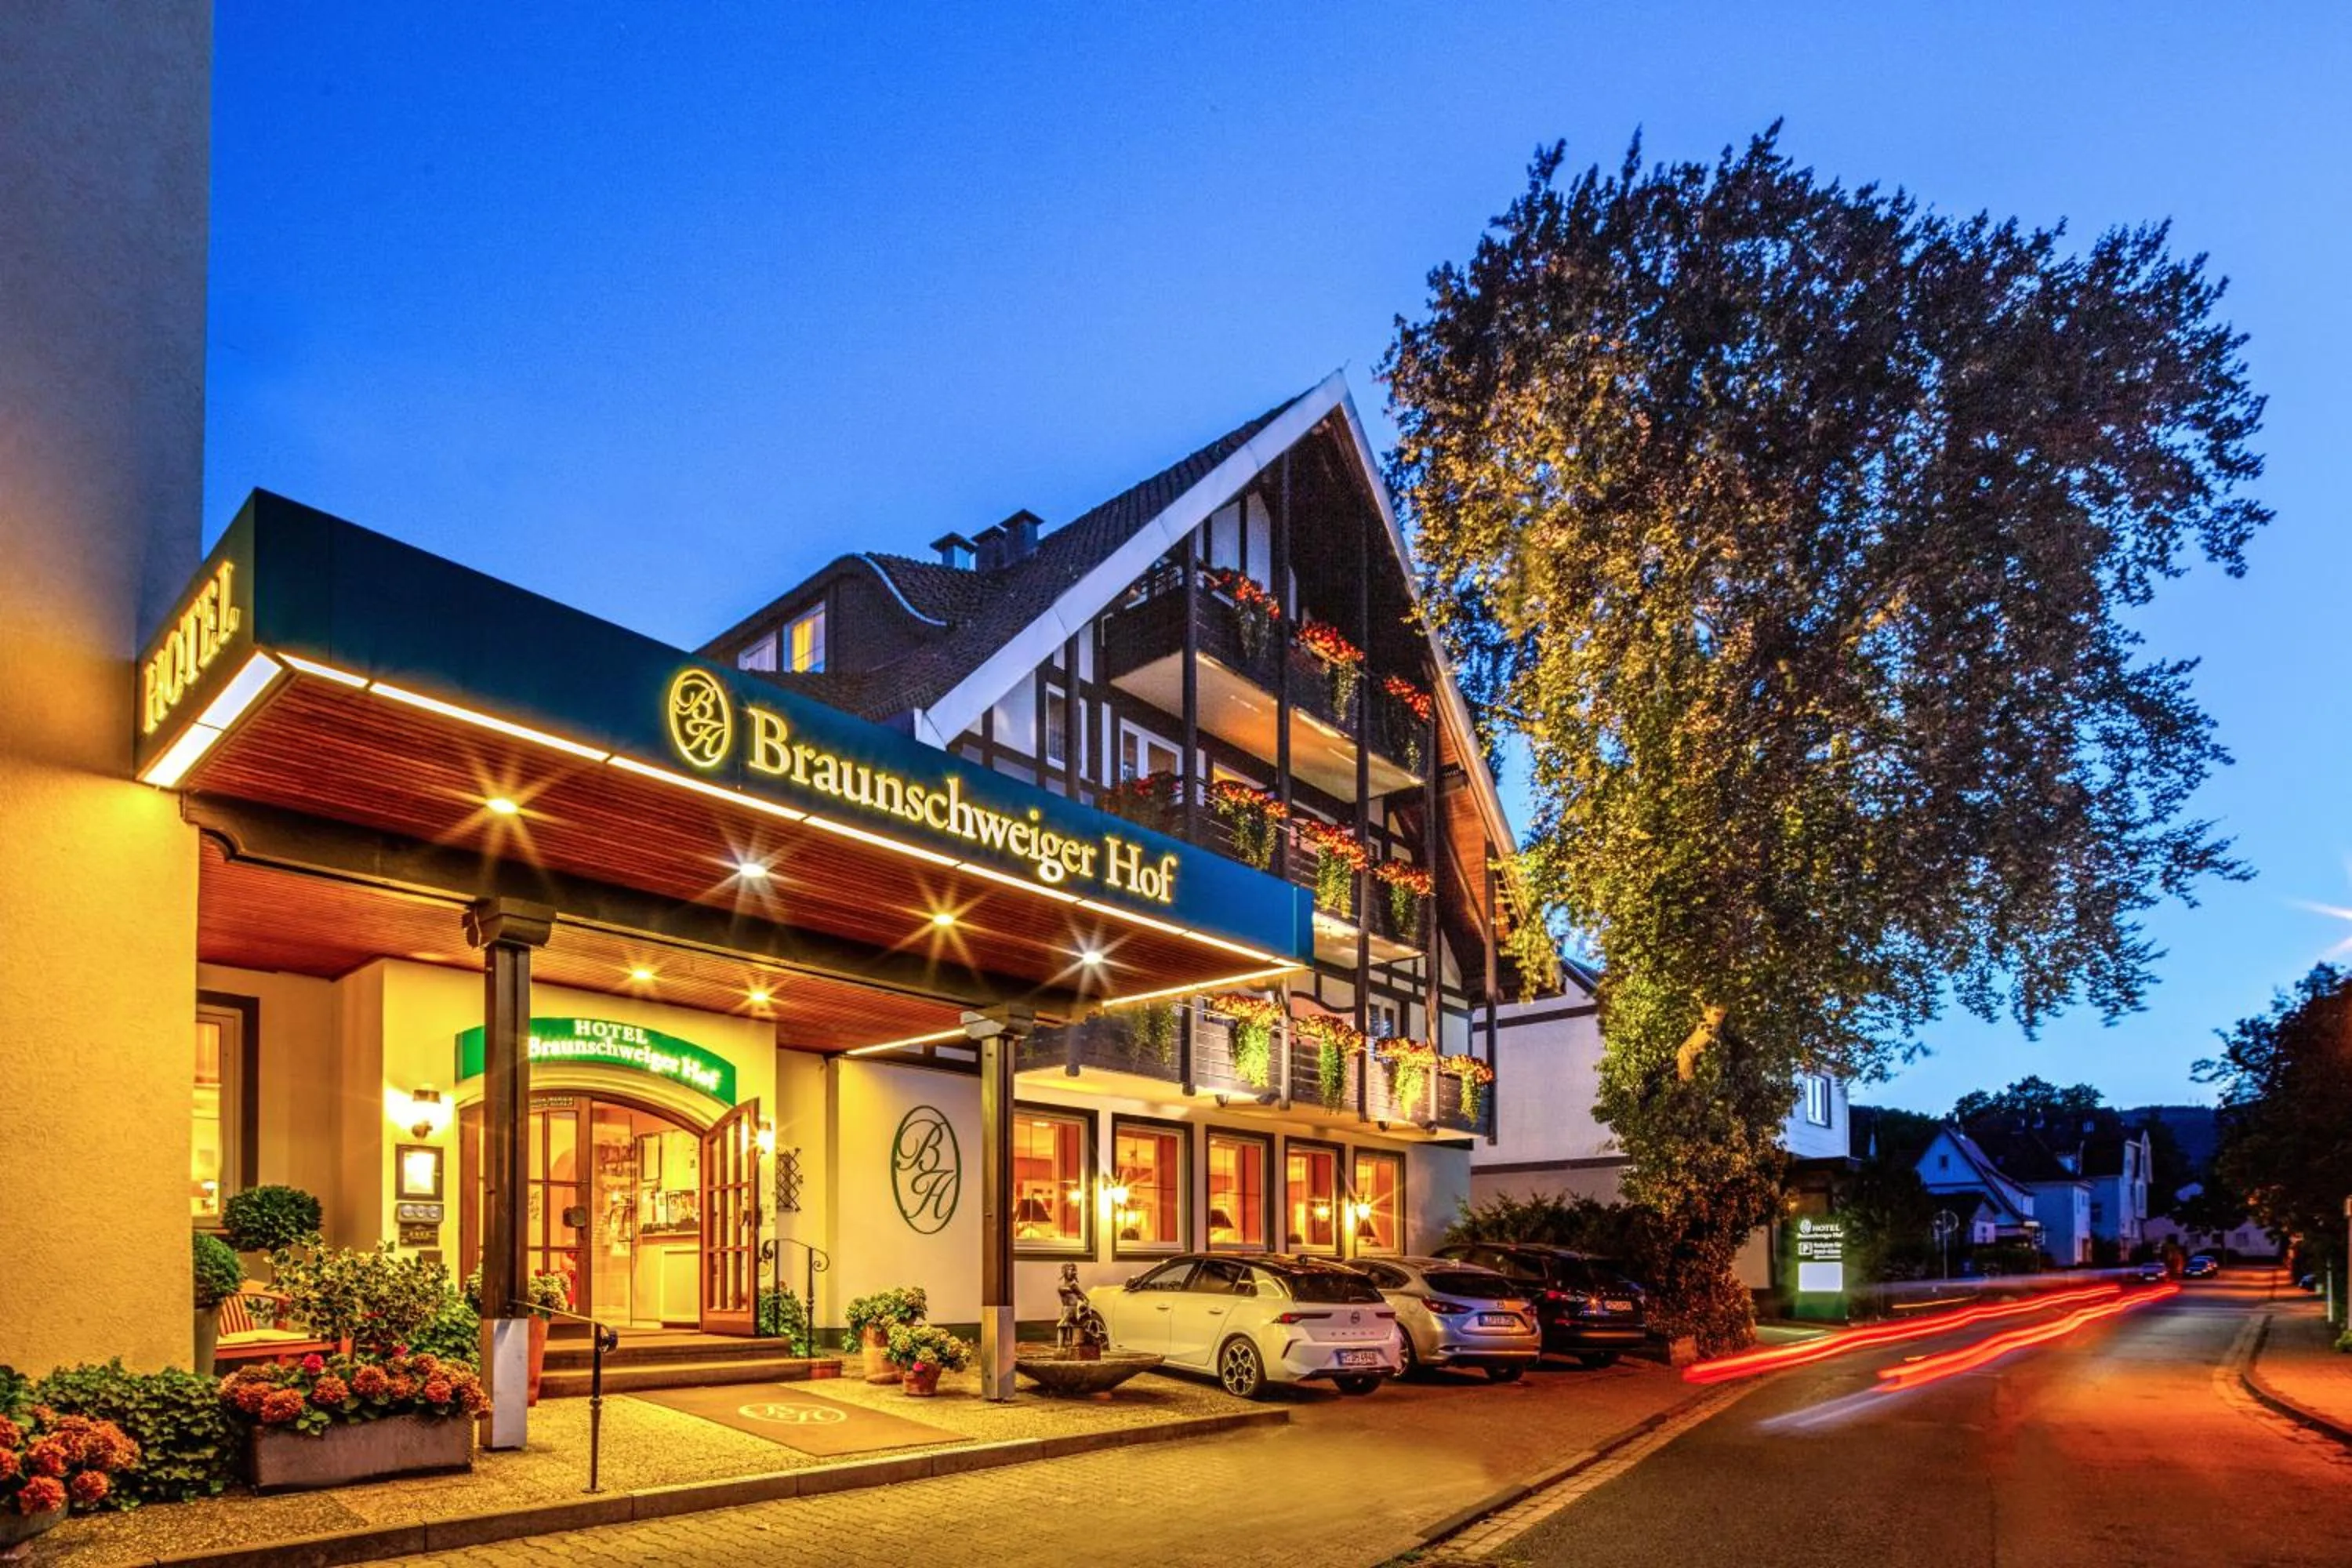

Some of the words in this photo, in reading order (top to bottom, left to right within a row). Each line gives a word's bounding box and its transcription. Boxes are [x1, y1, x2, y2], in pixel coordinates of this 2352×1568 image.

[143, 560, 240, 735] HOTEL
[748, 706, 1095, 884] Braunschweiger
[1105, 837, 1178, 903] Hof
[529, 1036, 679, 1073] Braunschweiger
[681, 1055, 720, 1091] Hof
[574, 1019, 648, 1044] HOTEL
